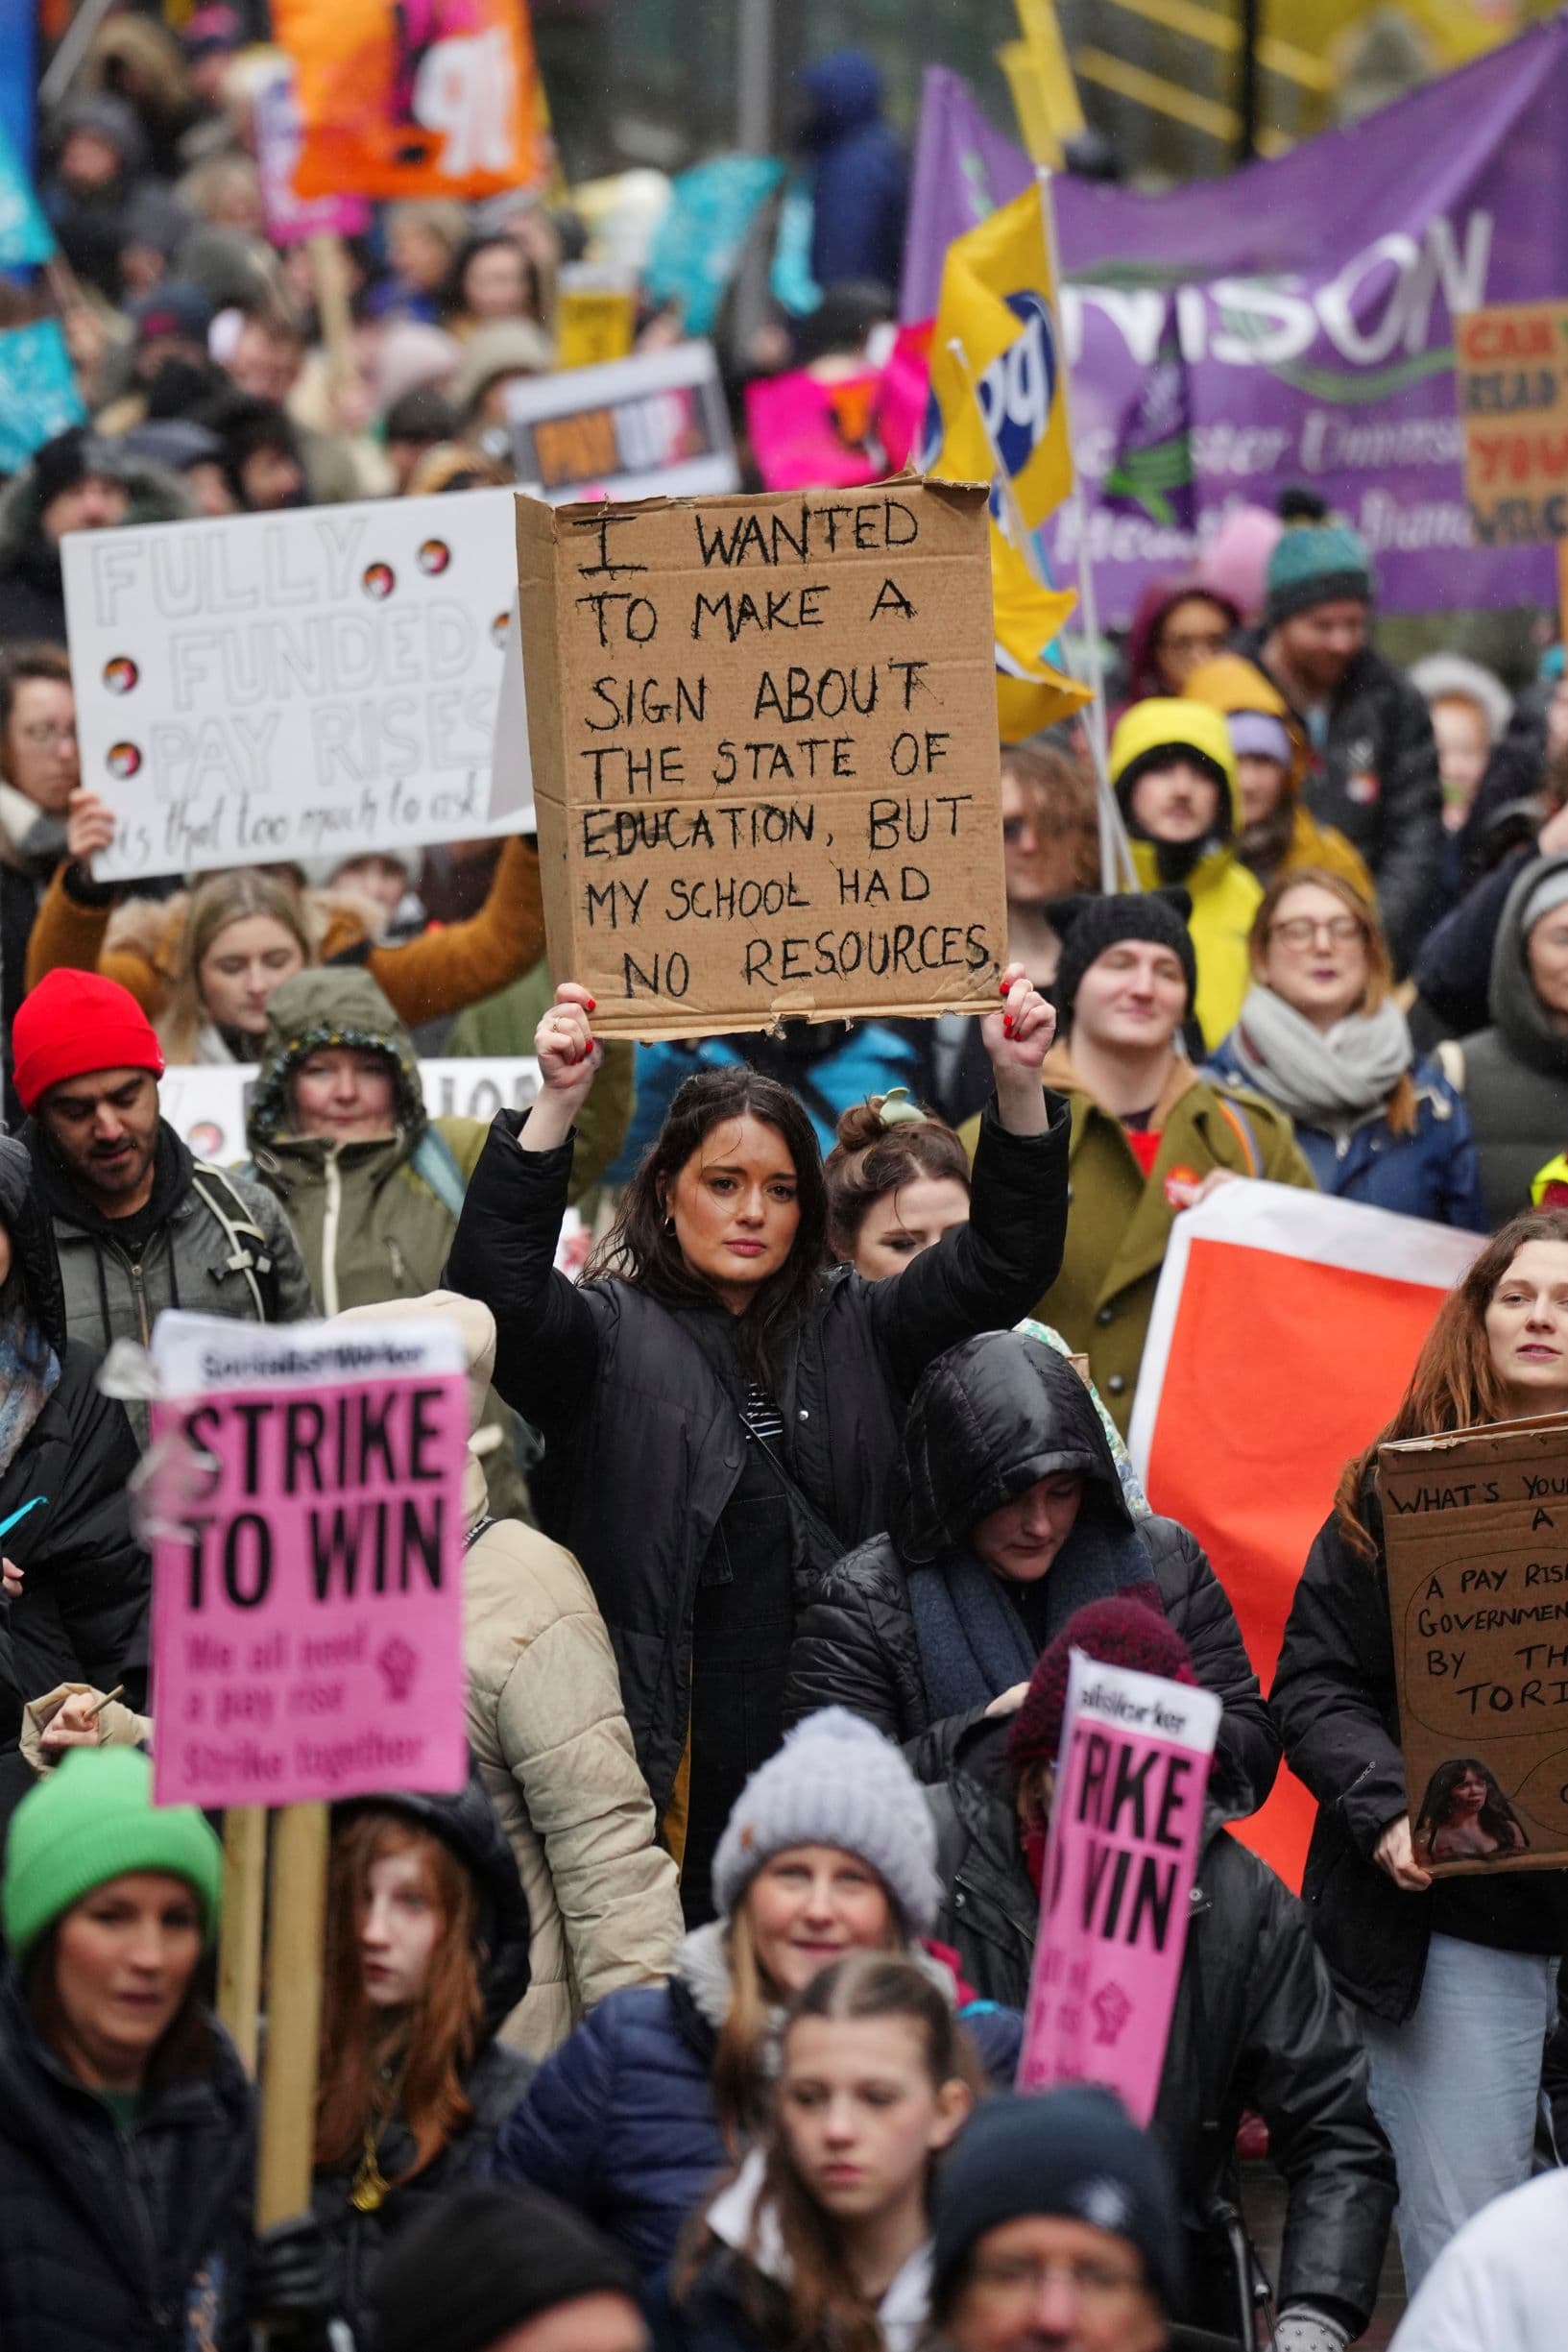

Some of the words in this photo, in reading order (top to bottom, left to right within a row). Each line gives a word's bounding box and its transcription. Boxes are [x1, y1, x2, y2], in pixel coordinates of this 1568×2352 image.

[90, 517, 371, 627] FULLY
[571, 515, 648, 579] I
[694, 499, 919, 568] WANTED
[576, 592, 658, 648] TO
[690, 585, 831, 643] MAKE
[869, 578, 918, 622] A
[167, 601, 478, 712] FUNDED
[584, 675, 708, 733] SIGN
[753, 661, 930, 724] ABOUT
[148, 711, 283, 803] PAY
[581, 746, 685, 800] THE
[712, 739, 856, 786] STATE
[891, 731, 952, 777] OF
[582, 805, 835, 860] EDUCATION,
[869, 794, 973, 852] BUT
[586, 878, 649, 929] MY
[664, 871, 811, 923] SCHOOL
[837, 865, 931, 906] HAD
[623, 951, 690, 1000] NO
[184, 1387, 445, 1500] STRIKE
[1387, 1481, 1500, 1515] WHAT'S
[1522, 1474, 1568, 1501] YOU
[1532, 1506, 1555, 1532] A
[182, 1511, 275, 1612] TO
[307, 1493, 446, 1606] WIN
[1425, 1575, 1444, 1600] A
[1460, 1567, 1508, 1593] PAY
[1525, 1563, 1568, 1588] RIS
[1427, 1649, 1466, 1680] BY
